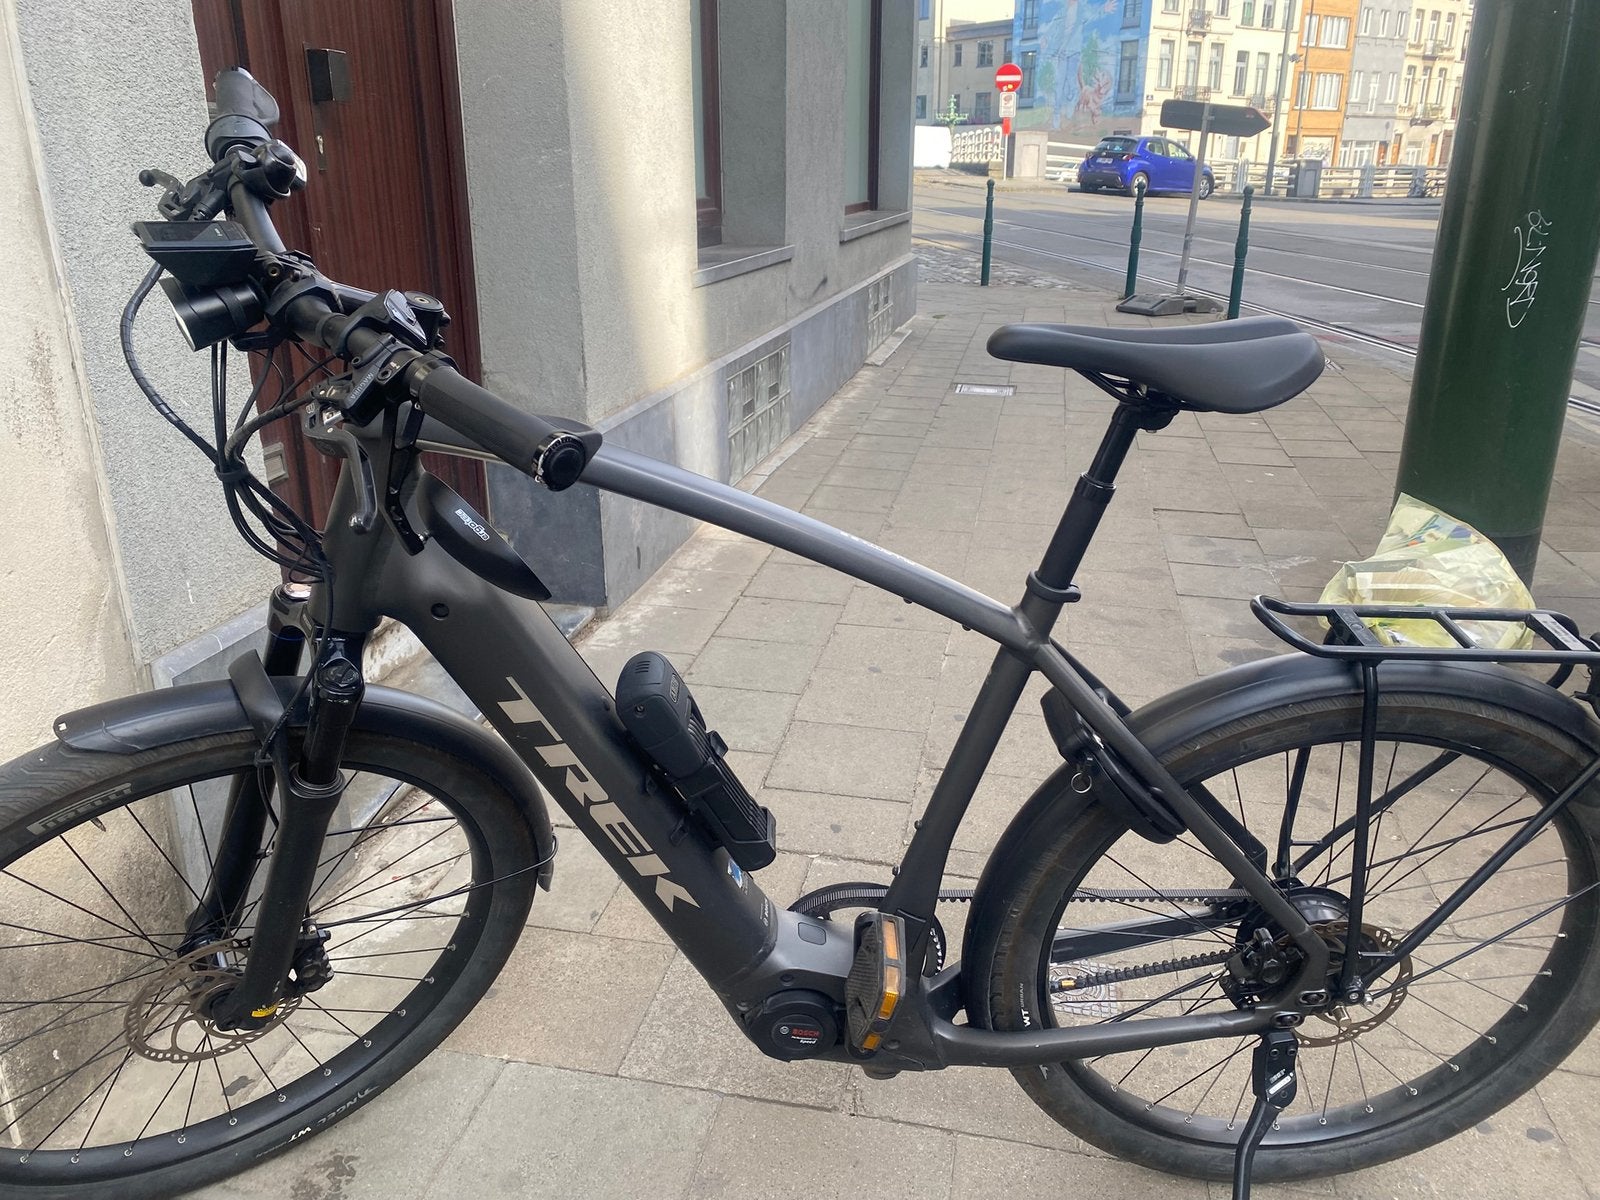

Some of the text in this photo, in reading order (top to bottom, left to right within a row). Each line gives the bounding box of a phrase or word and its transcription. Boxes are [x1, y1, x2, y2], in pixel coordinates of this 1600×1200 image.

[454, 508, 490, 541] ergotec
[26, 782, 133, 836] PIRELLI
[496, 676, 701, 912] TREK
[791, 1028, 821, 1038] BOSCH
[287, 1126, 312, 1143] WT
